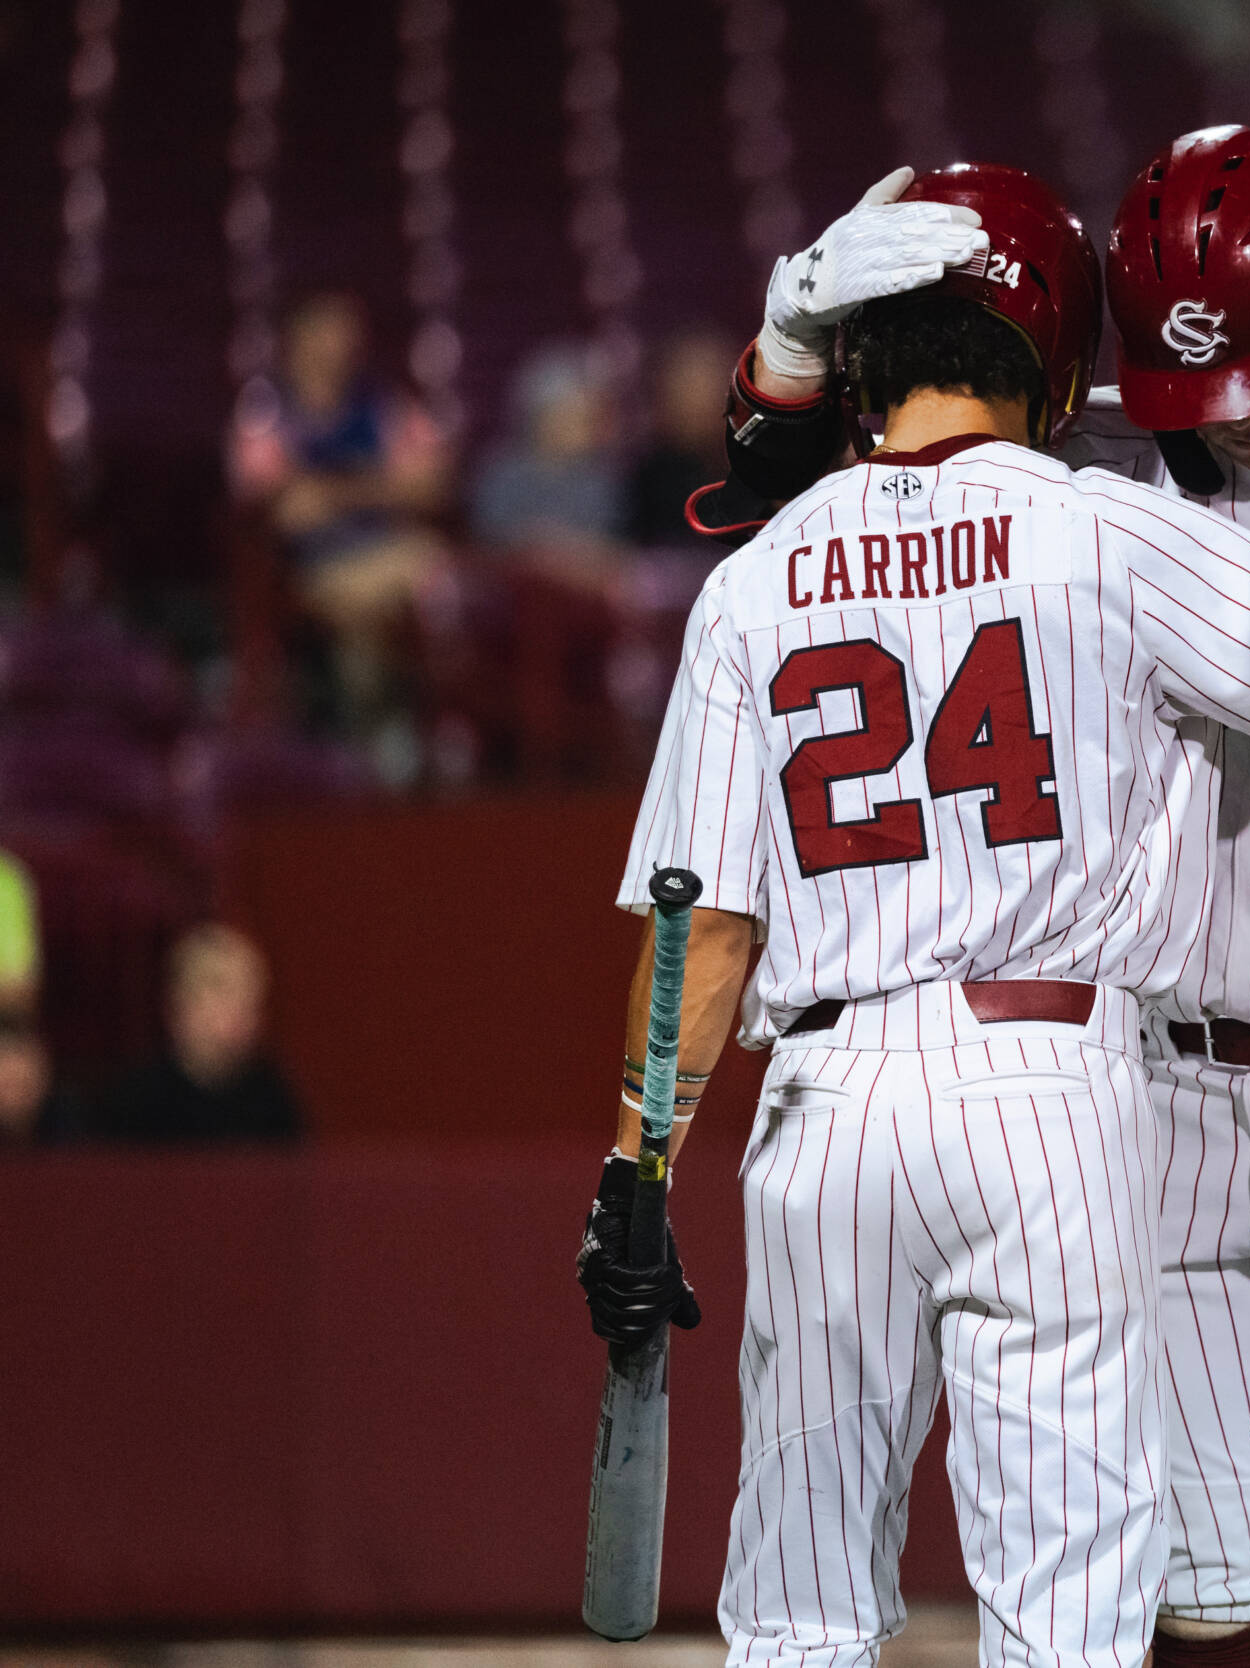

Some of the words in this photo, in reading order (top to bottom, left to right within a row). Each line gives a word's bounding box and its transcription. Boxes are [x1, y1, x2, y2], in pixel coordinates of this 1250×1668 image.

[986, 253, 1021, 289] 24
[881, 473, 922, 499] SEC
[788, 515, 1012, 609] CARRION
[768, 616, 1063, 879] 24
